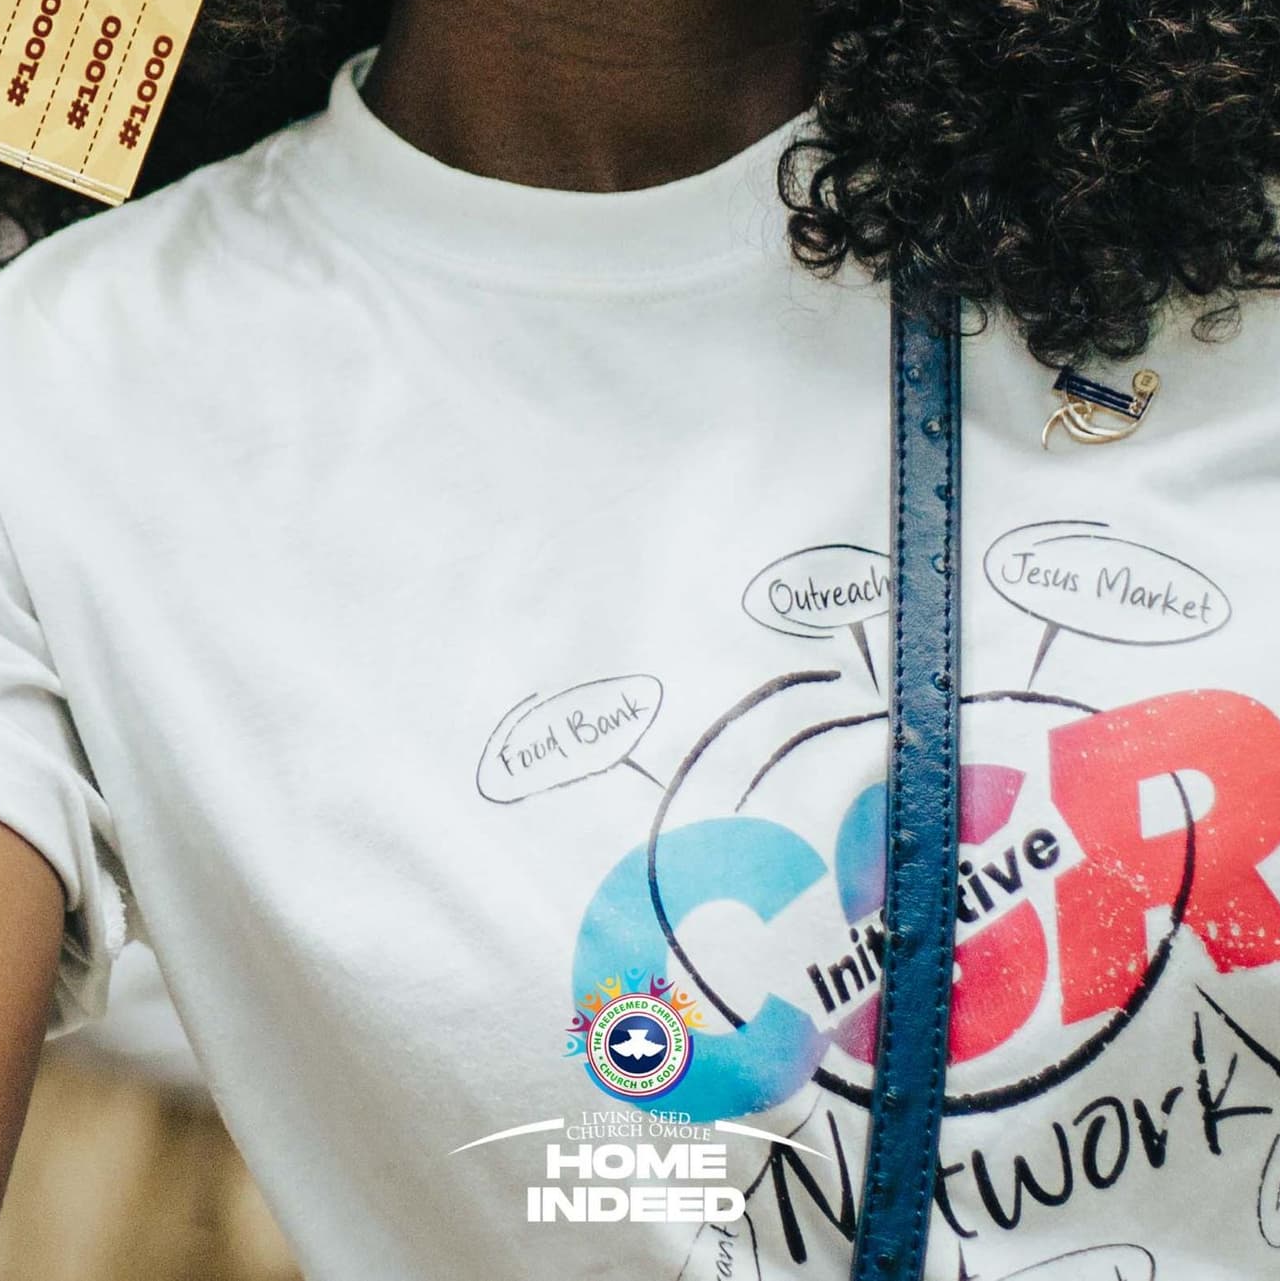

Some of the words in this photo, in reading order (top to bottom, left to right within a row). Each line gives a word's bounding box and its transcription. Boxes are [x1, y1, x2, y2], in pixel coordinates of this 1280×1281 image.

[66, 15, 122, 131] #1000
[118, 34, 174, 150] #1000
[768, 565, 890, 617] Outreach
[1001, 552, 1079, 593] Jesus
[1096, 566, 1213, 624] Market
[567, 692, 650, 744] Bank
[806, 828, 1061, 1015] Inittive
[768, 1010, 1273, 1265] Ntwork
